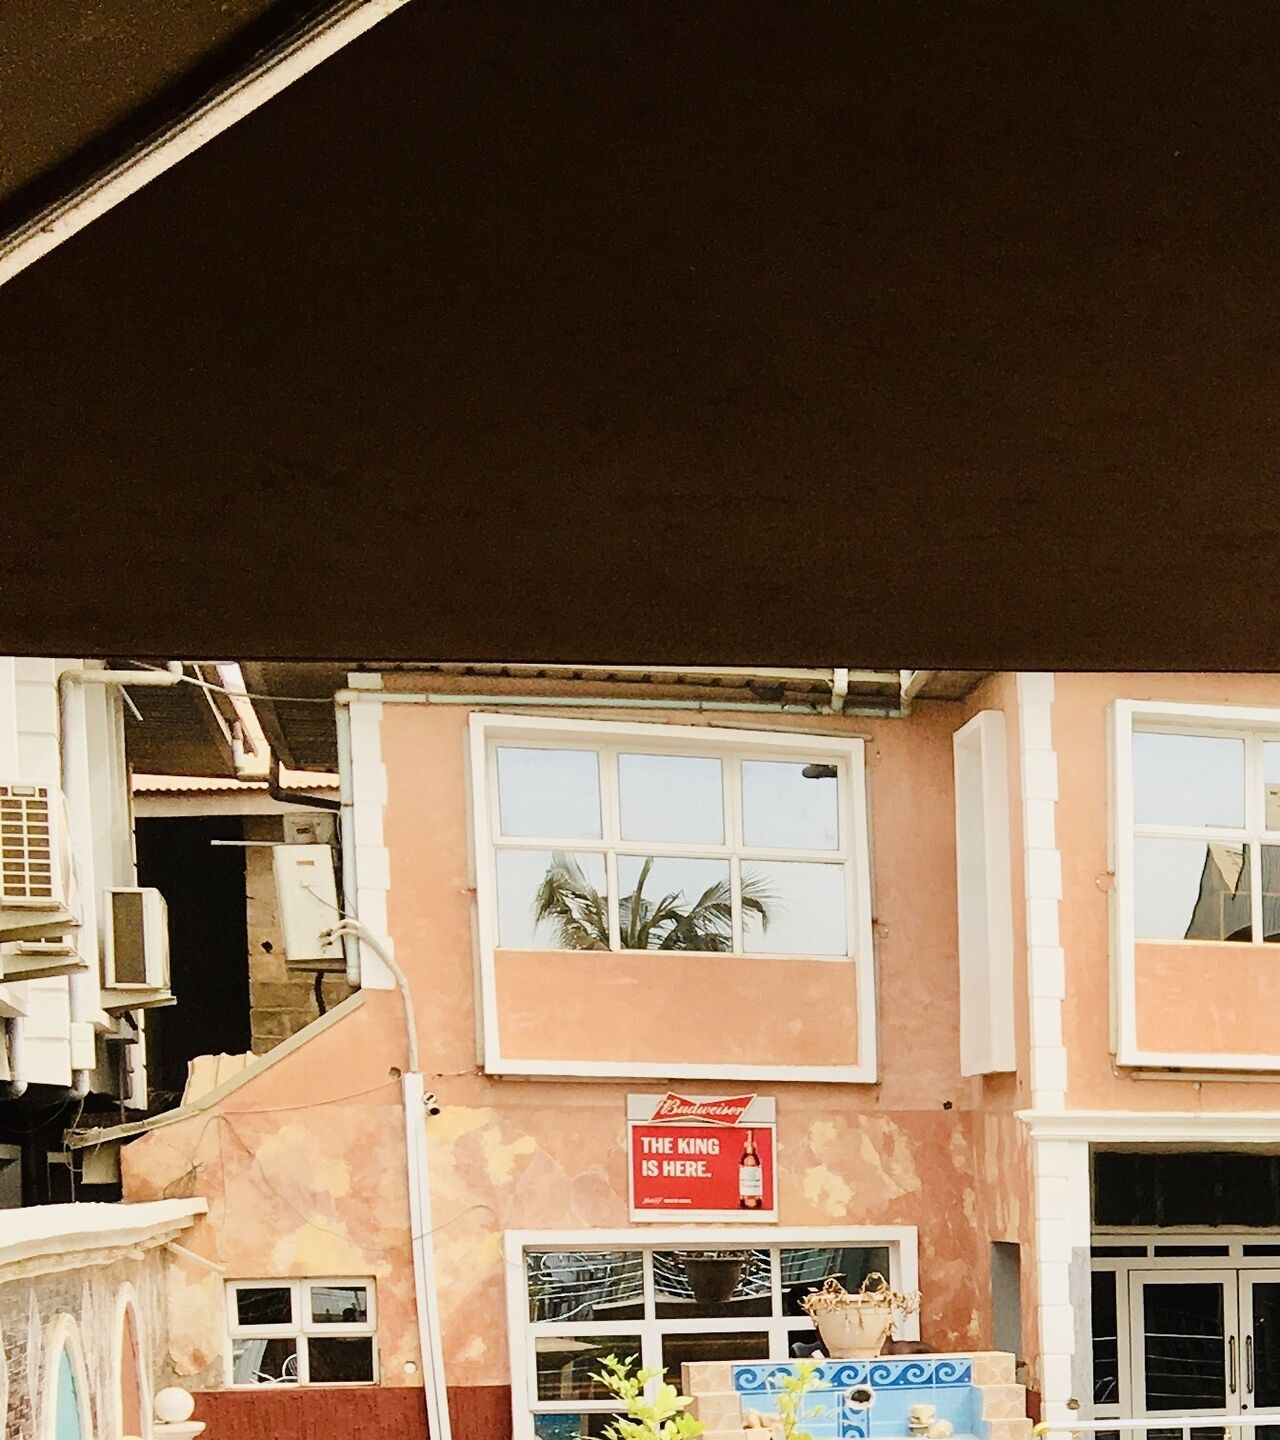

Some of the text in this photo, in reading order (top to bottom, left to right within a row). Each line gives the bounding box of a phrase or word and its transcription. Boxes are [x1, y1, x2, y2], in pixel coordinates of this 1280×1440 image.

[656, 1099, 746, 1116] Budweiser
[640, 1137, 720, 1155] THE KING
[641, 1160, 712, 1178] IS HERE.
